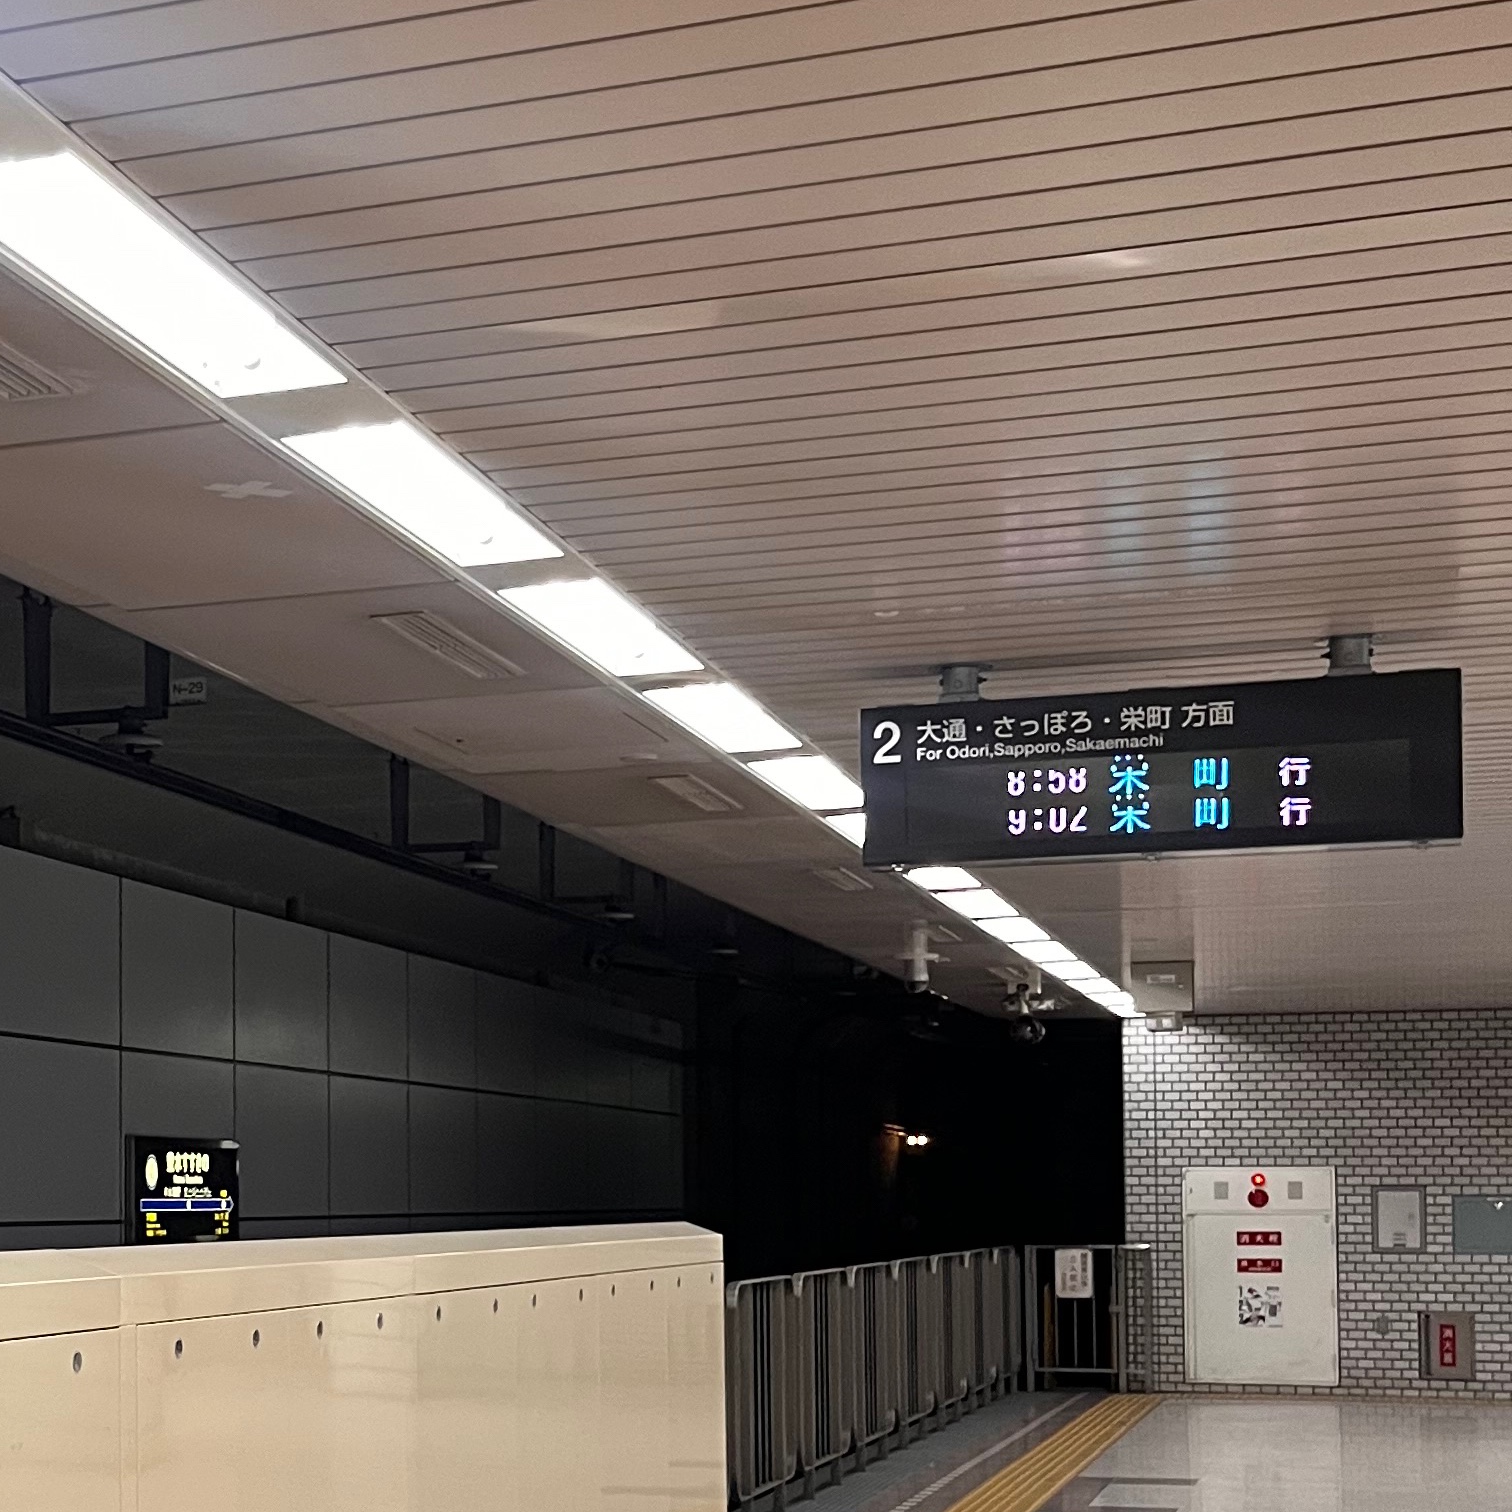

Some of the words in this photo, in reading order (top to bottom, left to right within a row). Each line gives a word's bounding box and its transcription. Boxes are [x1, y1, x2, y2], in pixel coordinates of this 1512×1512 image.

[872, 721, 902, 764] 2
[916, 705, 1172, 743] 大通・さっぽろ・栄町
[1181, 700, 1235, 729] 方面
[916, 747, 942, 762] For
[946, 733, 1164, 759] Odori,Sapporo,Sakaemachi
